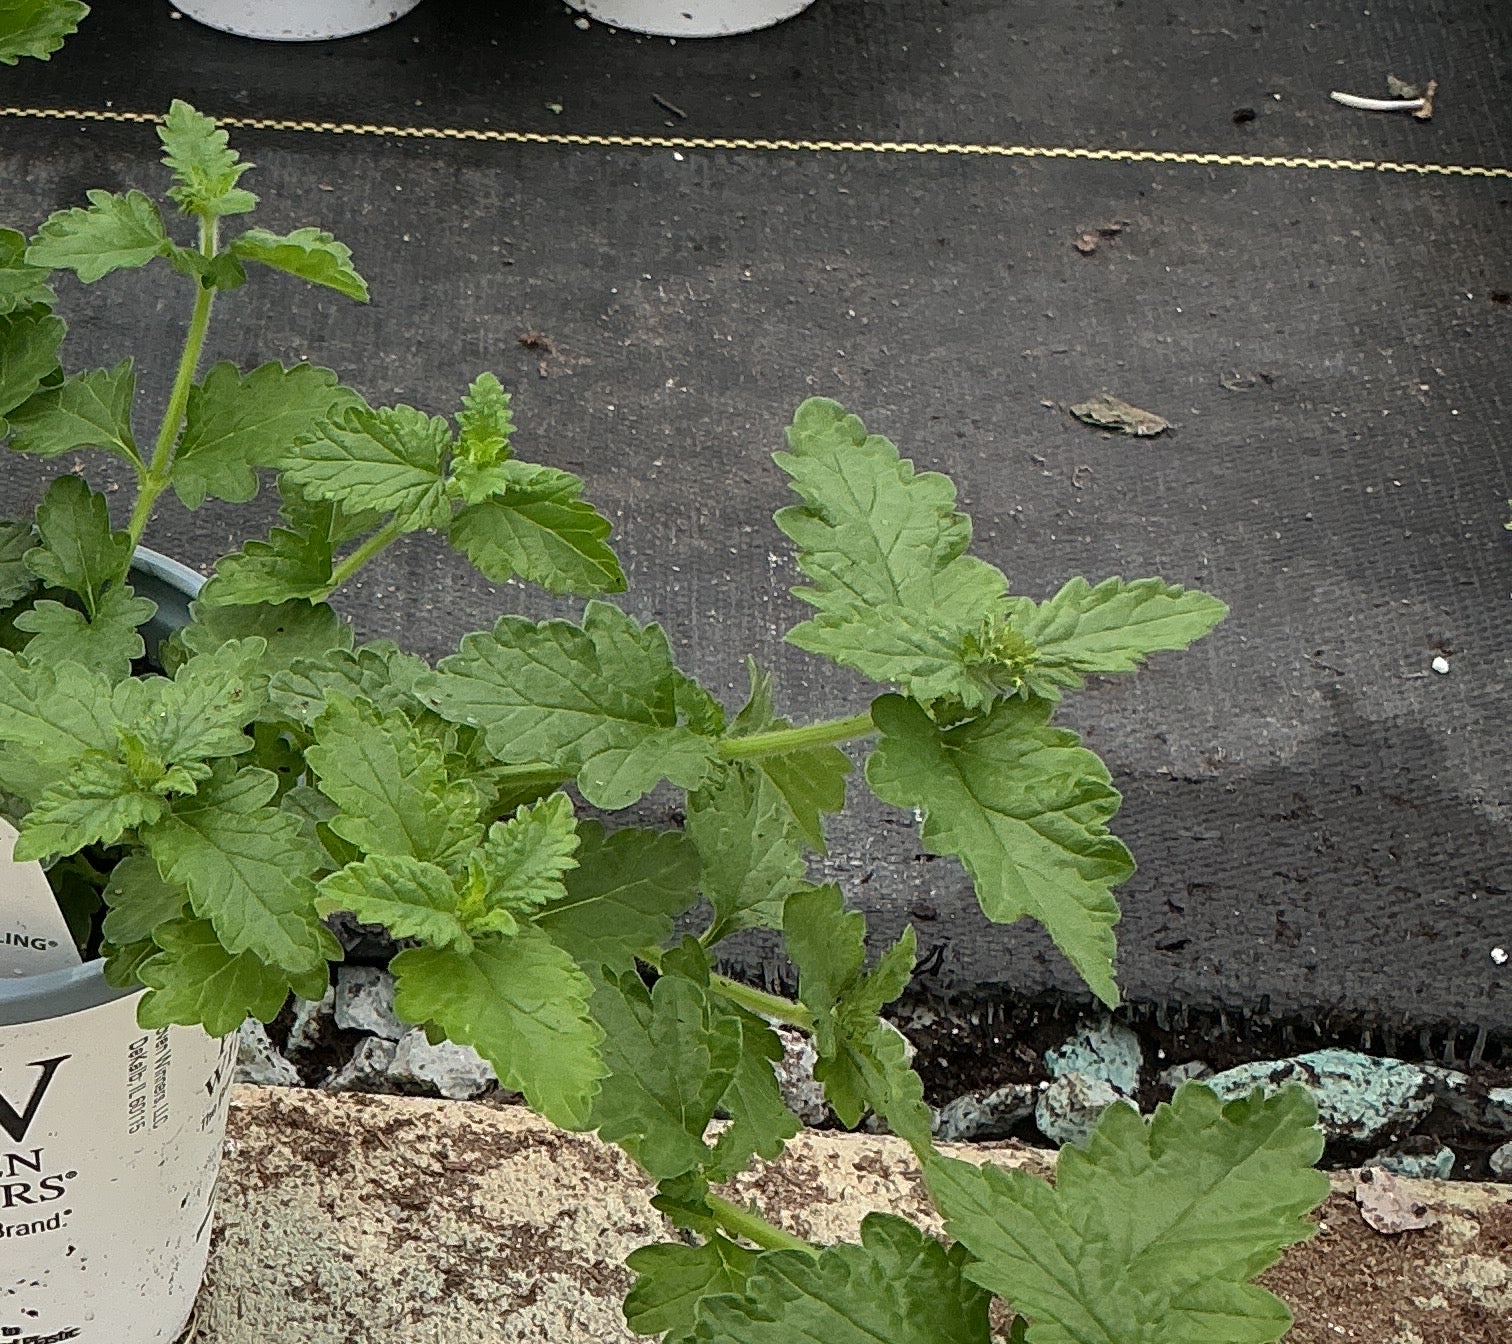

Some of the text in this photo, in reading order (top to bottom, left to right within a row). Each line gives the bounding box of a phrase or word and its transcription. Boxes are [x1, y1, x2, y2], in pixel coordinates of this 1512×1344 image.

[129, 1095, 146, 1134] 60115
[152, 1103, 168, 1129] LLC
[1, 1326, 21, 1337] to
